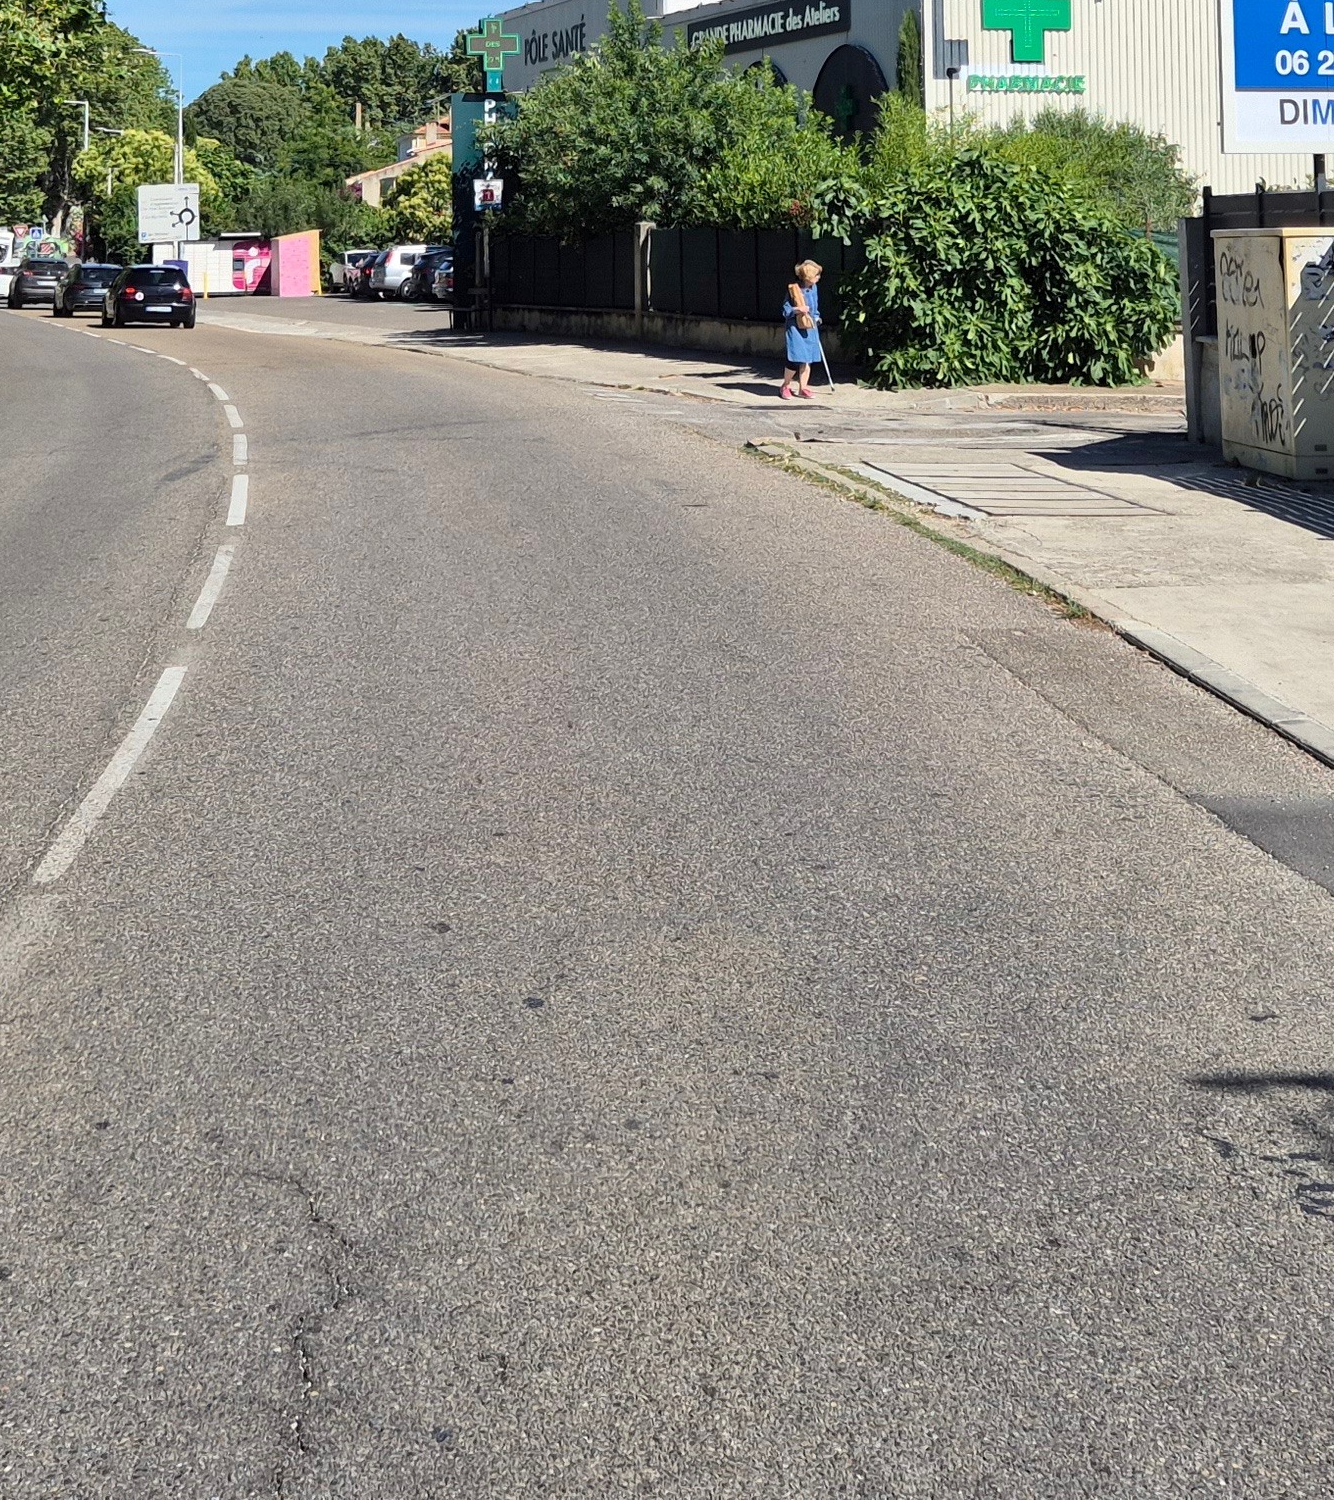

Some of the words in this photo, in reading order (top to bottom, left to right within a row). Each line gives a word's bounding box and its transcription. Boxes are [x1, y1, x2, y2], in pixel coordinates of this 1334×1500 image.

[730, 11, 784, 43] PHARMACIE
[786, 7, 802, 31] des
[803, 1, 840, 27] Ateliers
[524, 29, 548, 66] PÔLE
[551, 13, 586, 60] SANTÉ
[1275, 49, 1310, 76] 06
[967, 74, 1086, 95] PHARMACIE
